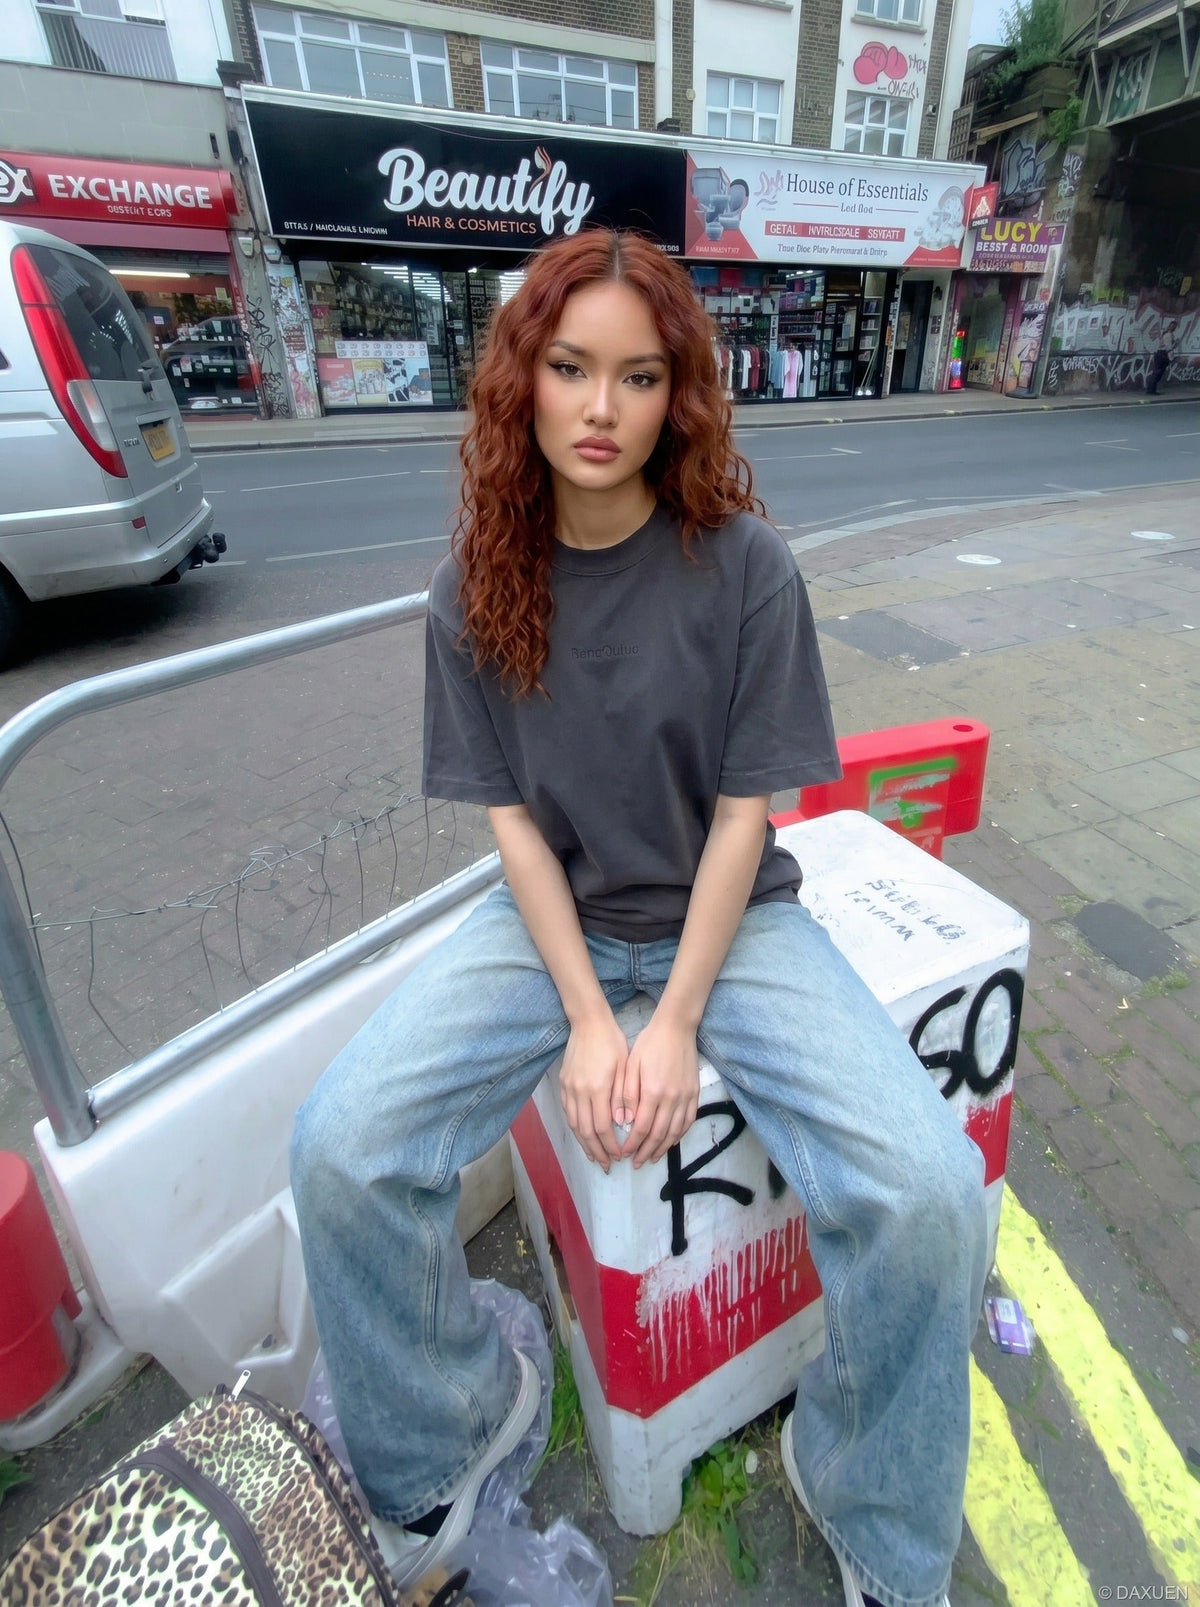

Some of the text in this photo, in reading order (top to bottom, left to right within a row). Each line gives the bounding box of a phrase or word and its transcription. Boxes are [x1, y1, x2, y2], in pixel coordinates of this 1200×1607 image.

[48, 174, 213, 209] EXCHANGE
[378, 146, 595, 236] Beautify
[786, 173, 834, 196] House
[838, 178, 855, 197] of
[857, 179, 929, 202] Essentials
[406, 214, 537, 235] HAIR & COSMETICS
[981, 220, 1043, 243] LUCY
[976, 241, 1048, 254] BESST & ROOM
